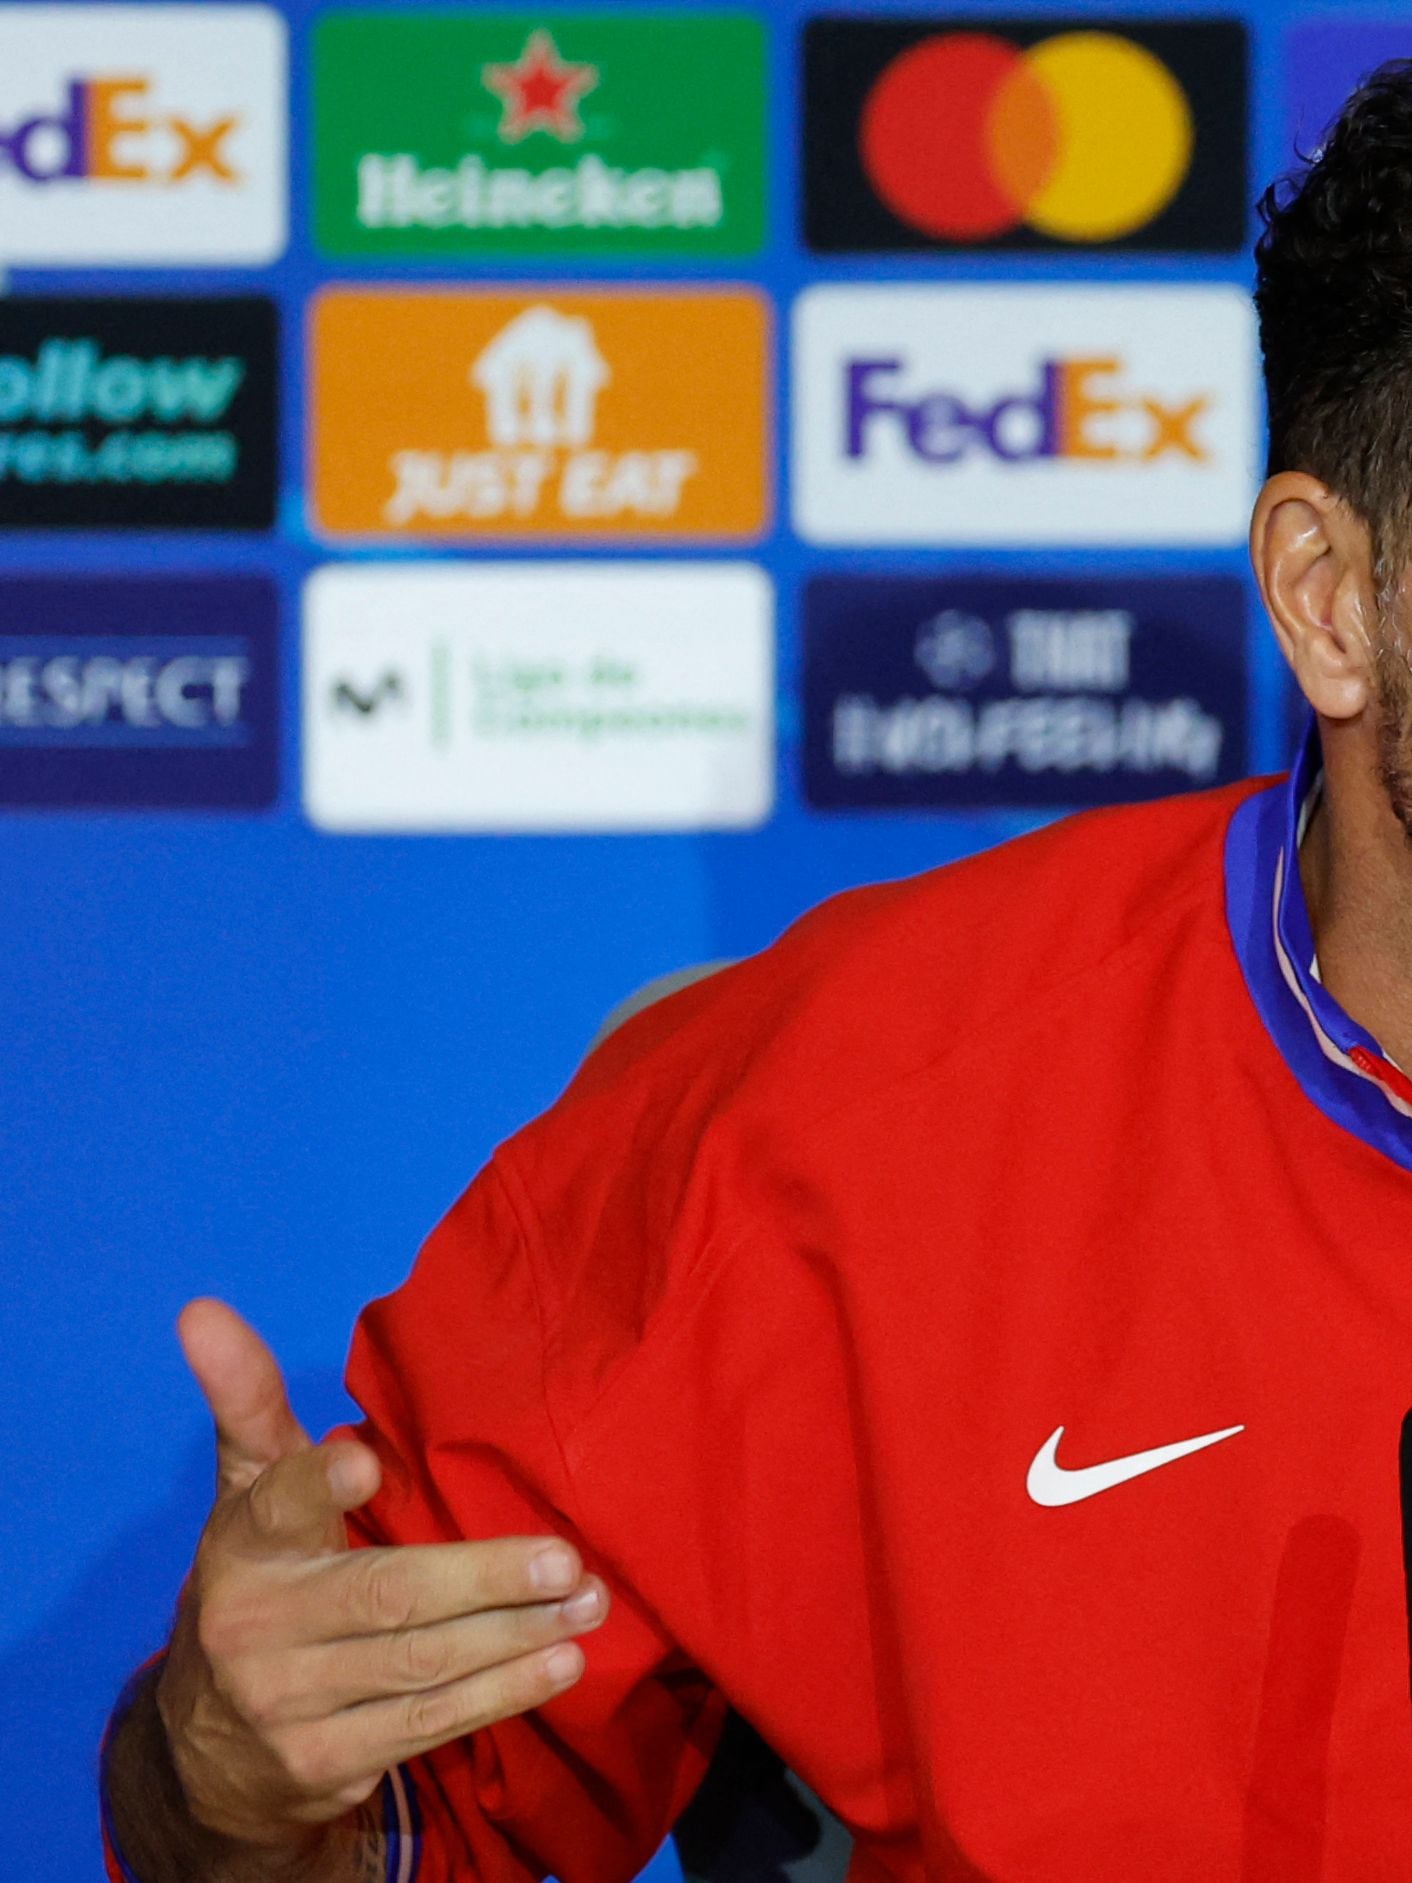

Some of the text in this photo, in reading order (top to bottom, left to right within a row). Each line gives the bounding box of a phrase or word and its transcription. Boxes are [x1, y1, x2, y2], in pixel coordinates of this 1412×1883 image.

[0, 77, 237, 182] dEx
[357, 153, 723, 228] Heineken
[842, 353, 1213, 464] FedEx
[383, 450, 696, 526] JUST EAT
[0, 655, 248, 728] ESPECT
